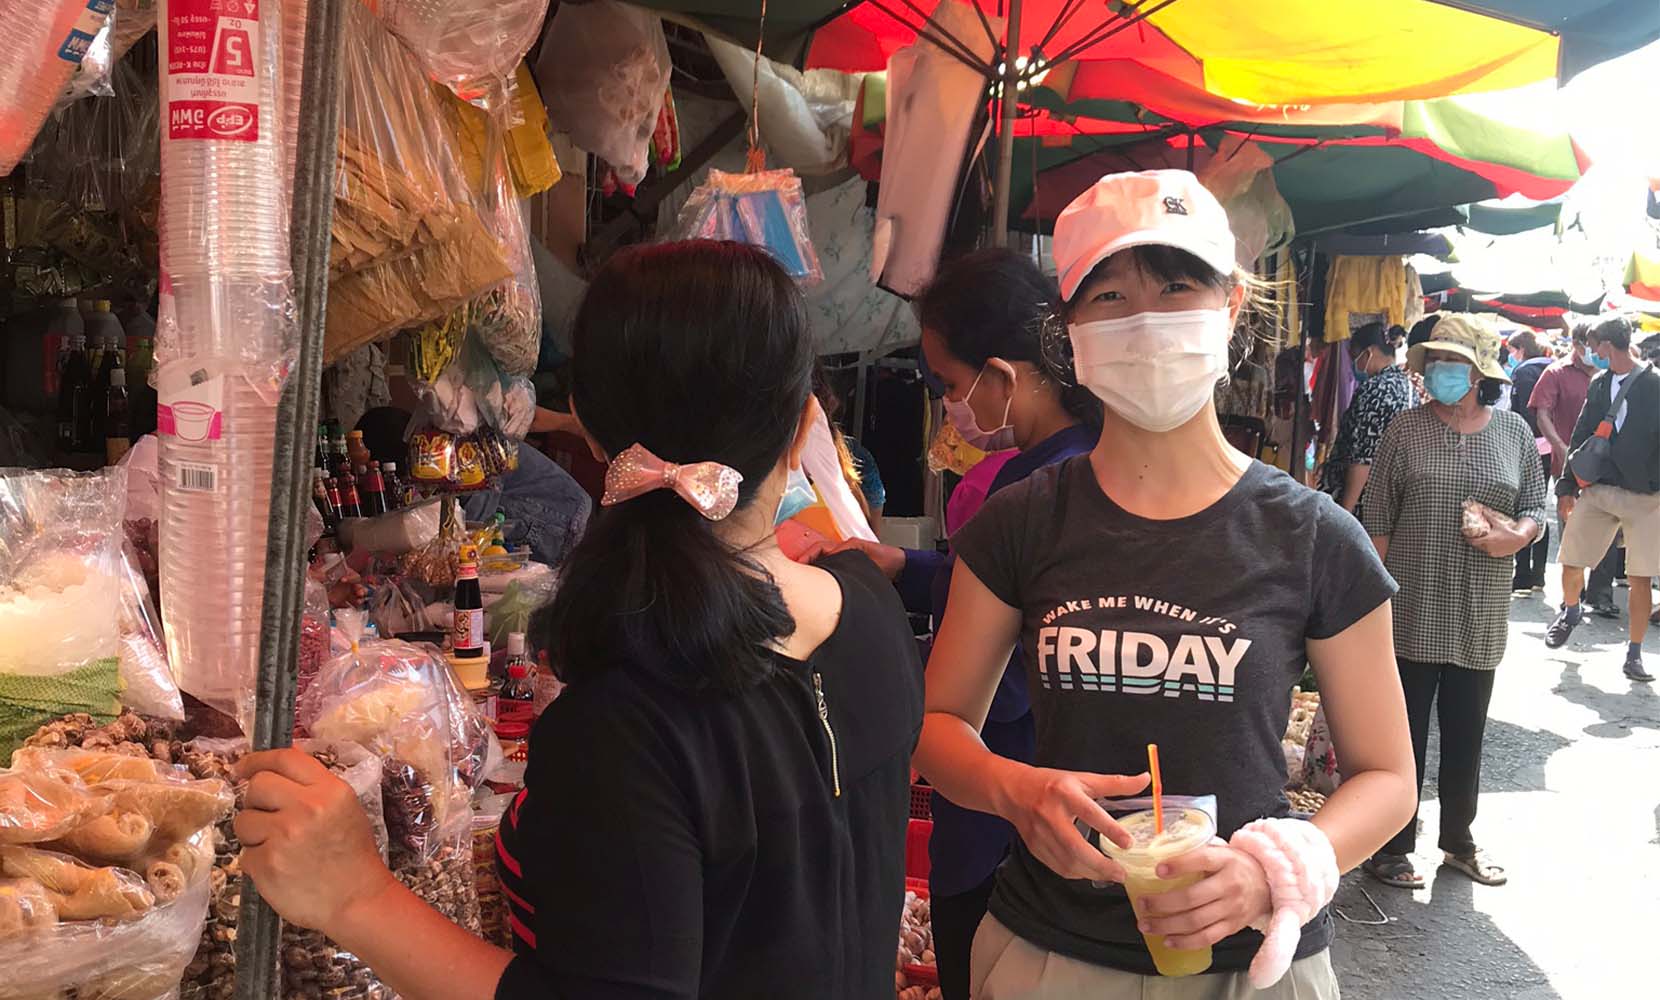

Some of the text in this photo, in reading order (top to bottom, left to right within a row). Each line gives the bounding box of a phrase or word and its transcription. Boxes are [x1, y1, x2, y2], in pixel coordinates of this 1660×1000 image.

[226, 36, 242, 66] 5
[1042, 595, 1238, 635] WAKE ME WHEN IT'S
[1037, 626, 1253, 690] FRIDAY
